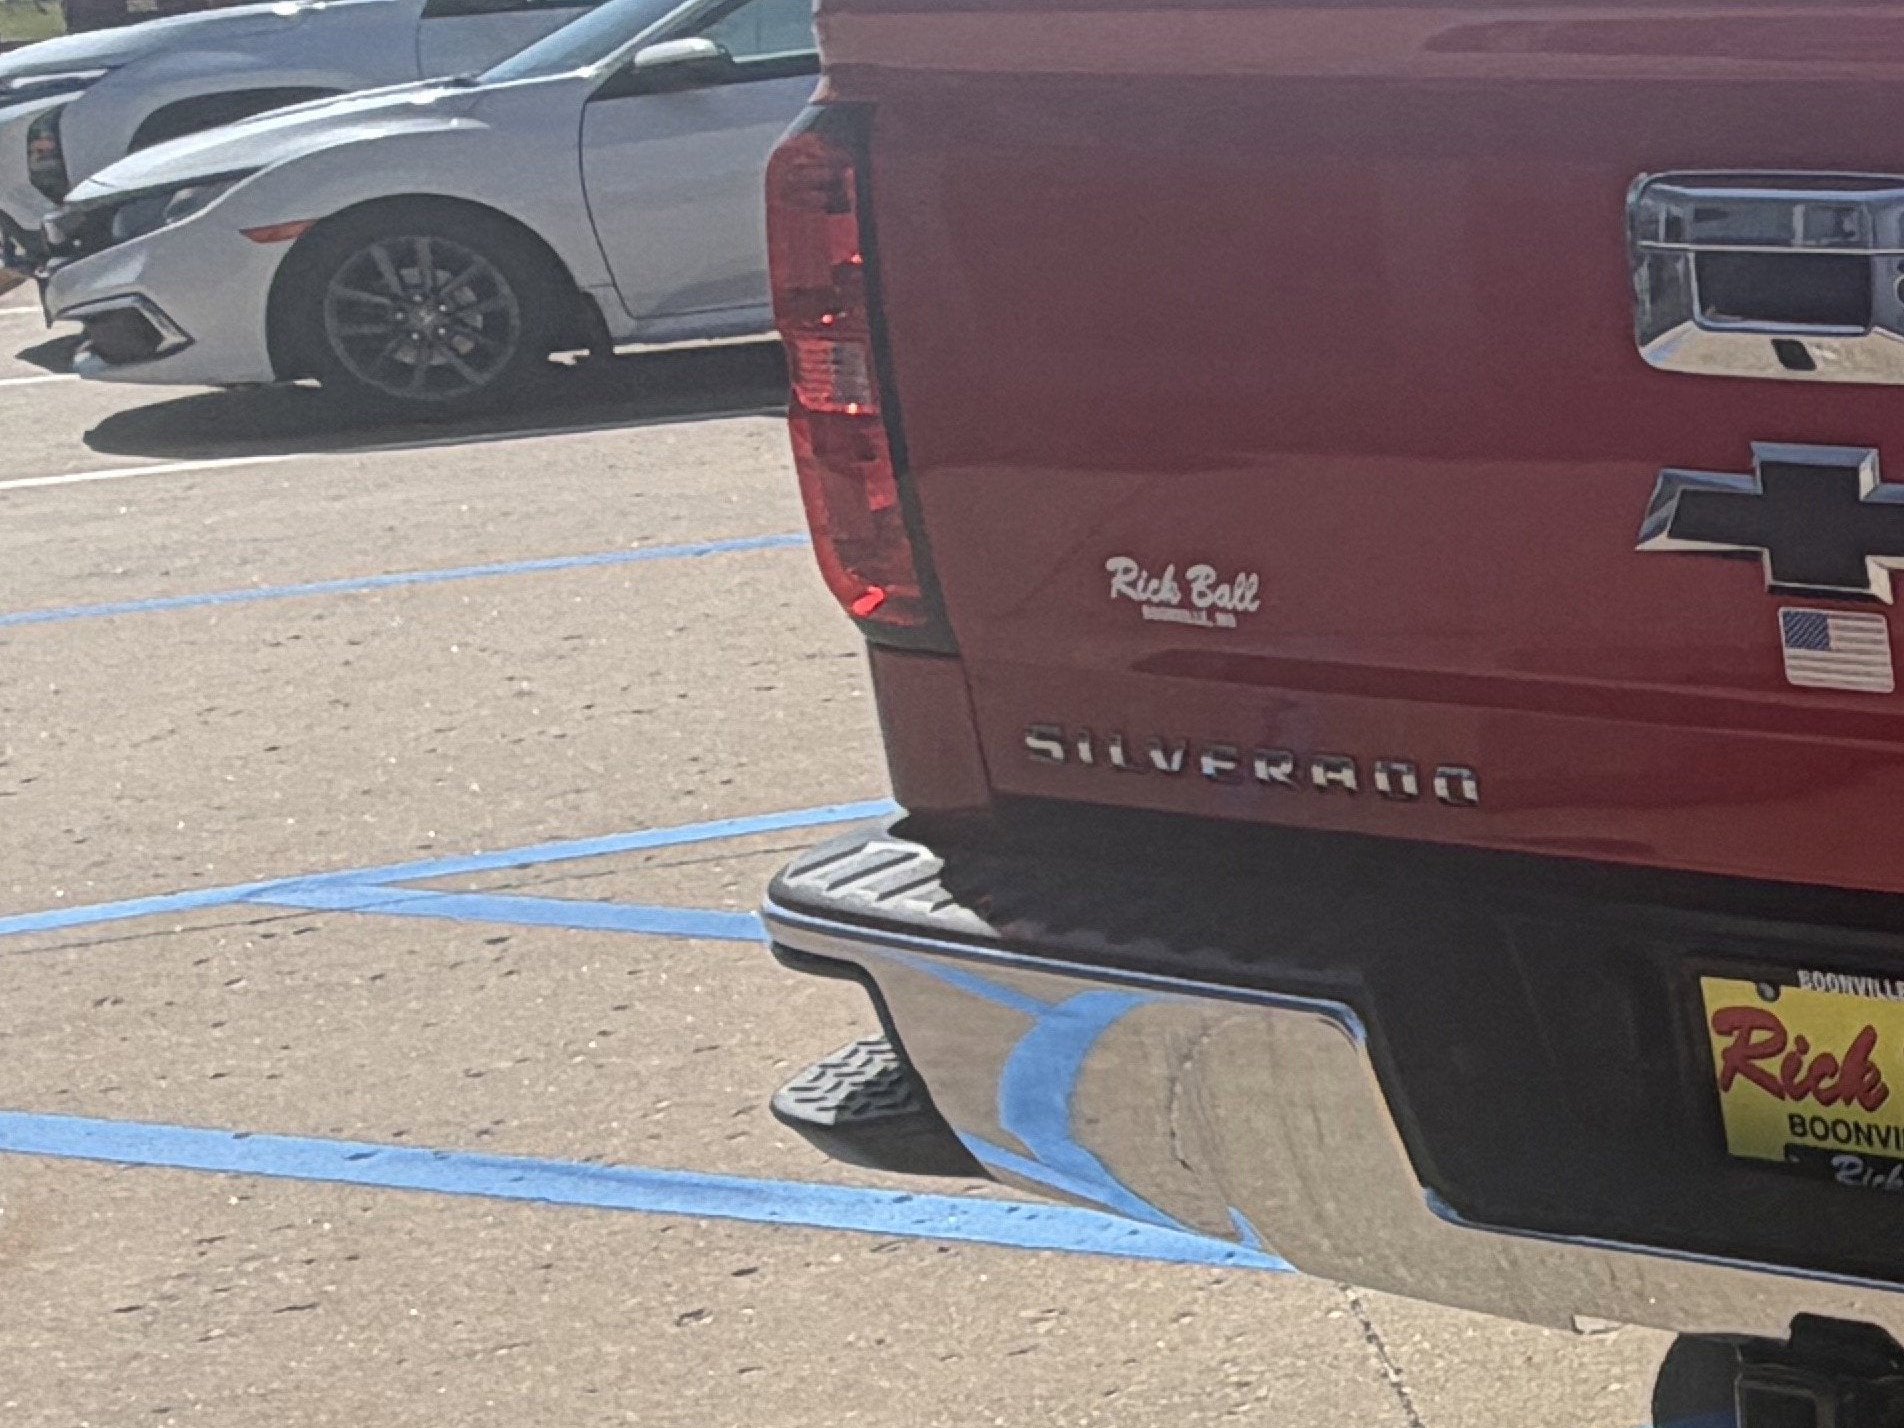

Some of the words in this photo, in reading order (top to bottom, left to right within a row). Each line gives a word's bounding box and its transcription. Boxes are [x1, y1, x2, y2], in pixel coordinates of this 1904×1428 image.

[1105, 556, 1181, 605] Rick
[1185, 564, 1261, 612] Ball
[1023, 723, 1480, 806] SILVERADO
[1711, 1005, 1890, 1113] Rick
